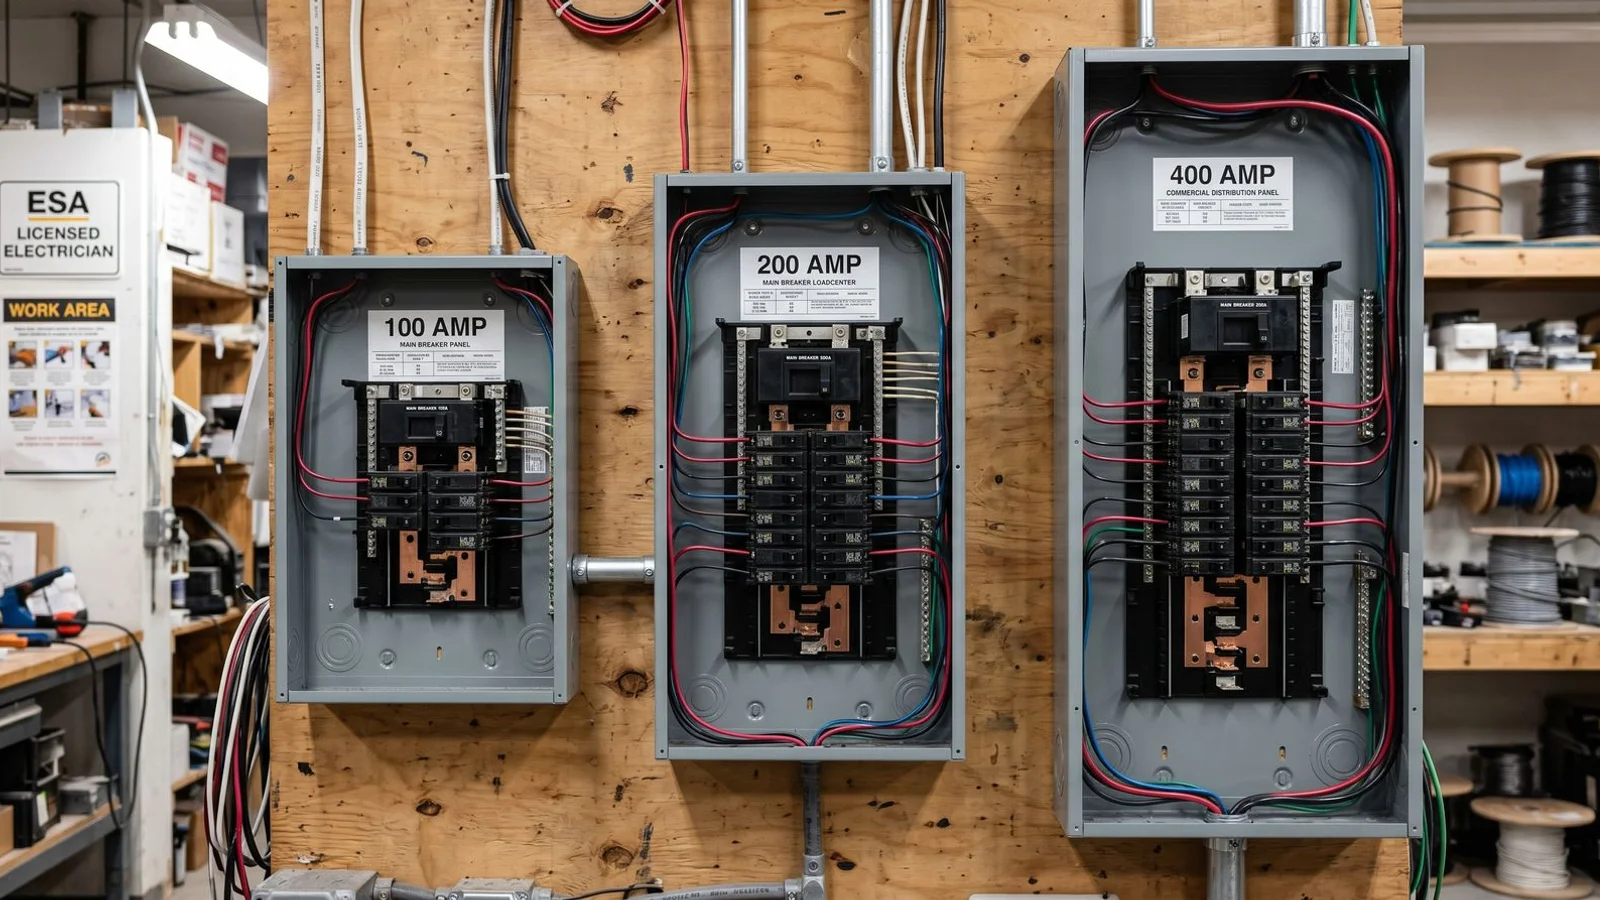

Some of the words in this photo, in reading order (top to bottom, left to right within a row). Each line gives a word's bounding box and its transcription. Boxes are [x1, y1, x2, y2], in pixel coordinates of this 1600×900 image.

[1170, 164, 1212, 185] 400
[1219, 164, 1275, 185] AMP
[28, 190, 89, 214] ESA
[17, 226, 100, 240] LICENSED
[4, 244, 113, 258] ELECTRICIAN
[757, 254, 799, 274] 200
[806, 254, 862, 274] AMP
[8, 302, 60, 318] WORK
[63, 302, 110, 318] AREA
[385, 317, 425, 337] 100
[432, 316, 487, 337] AMP
